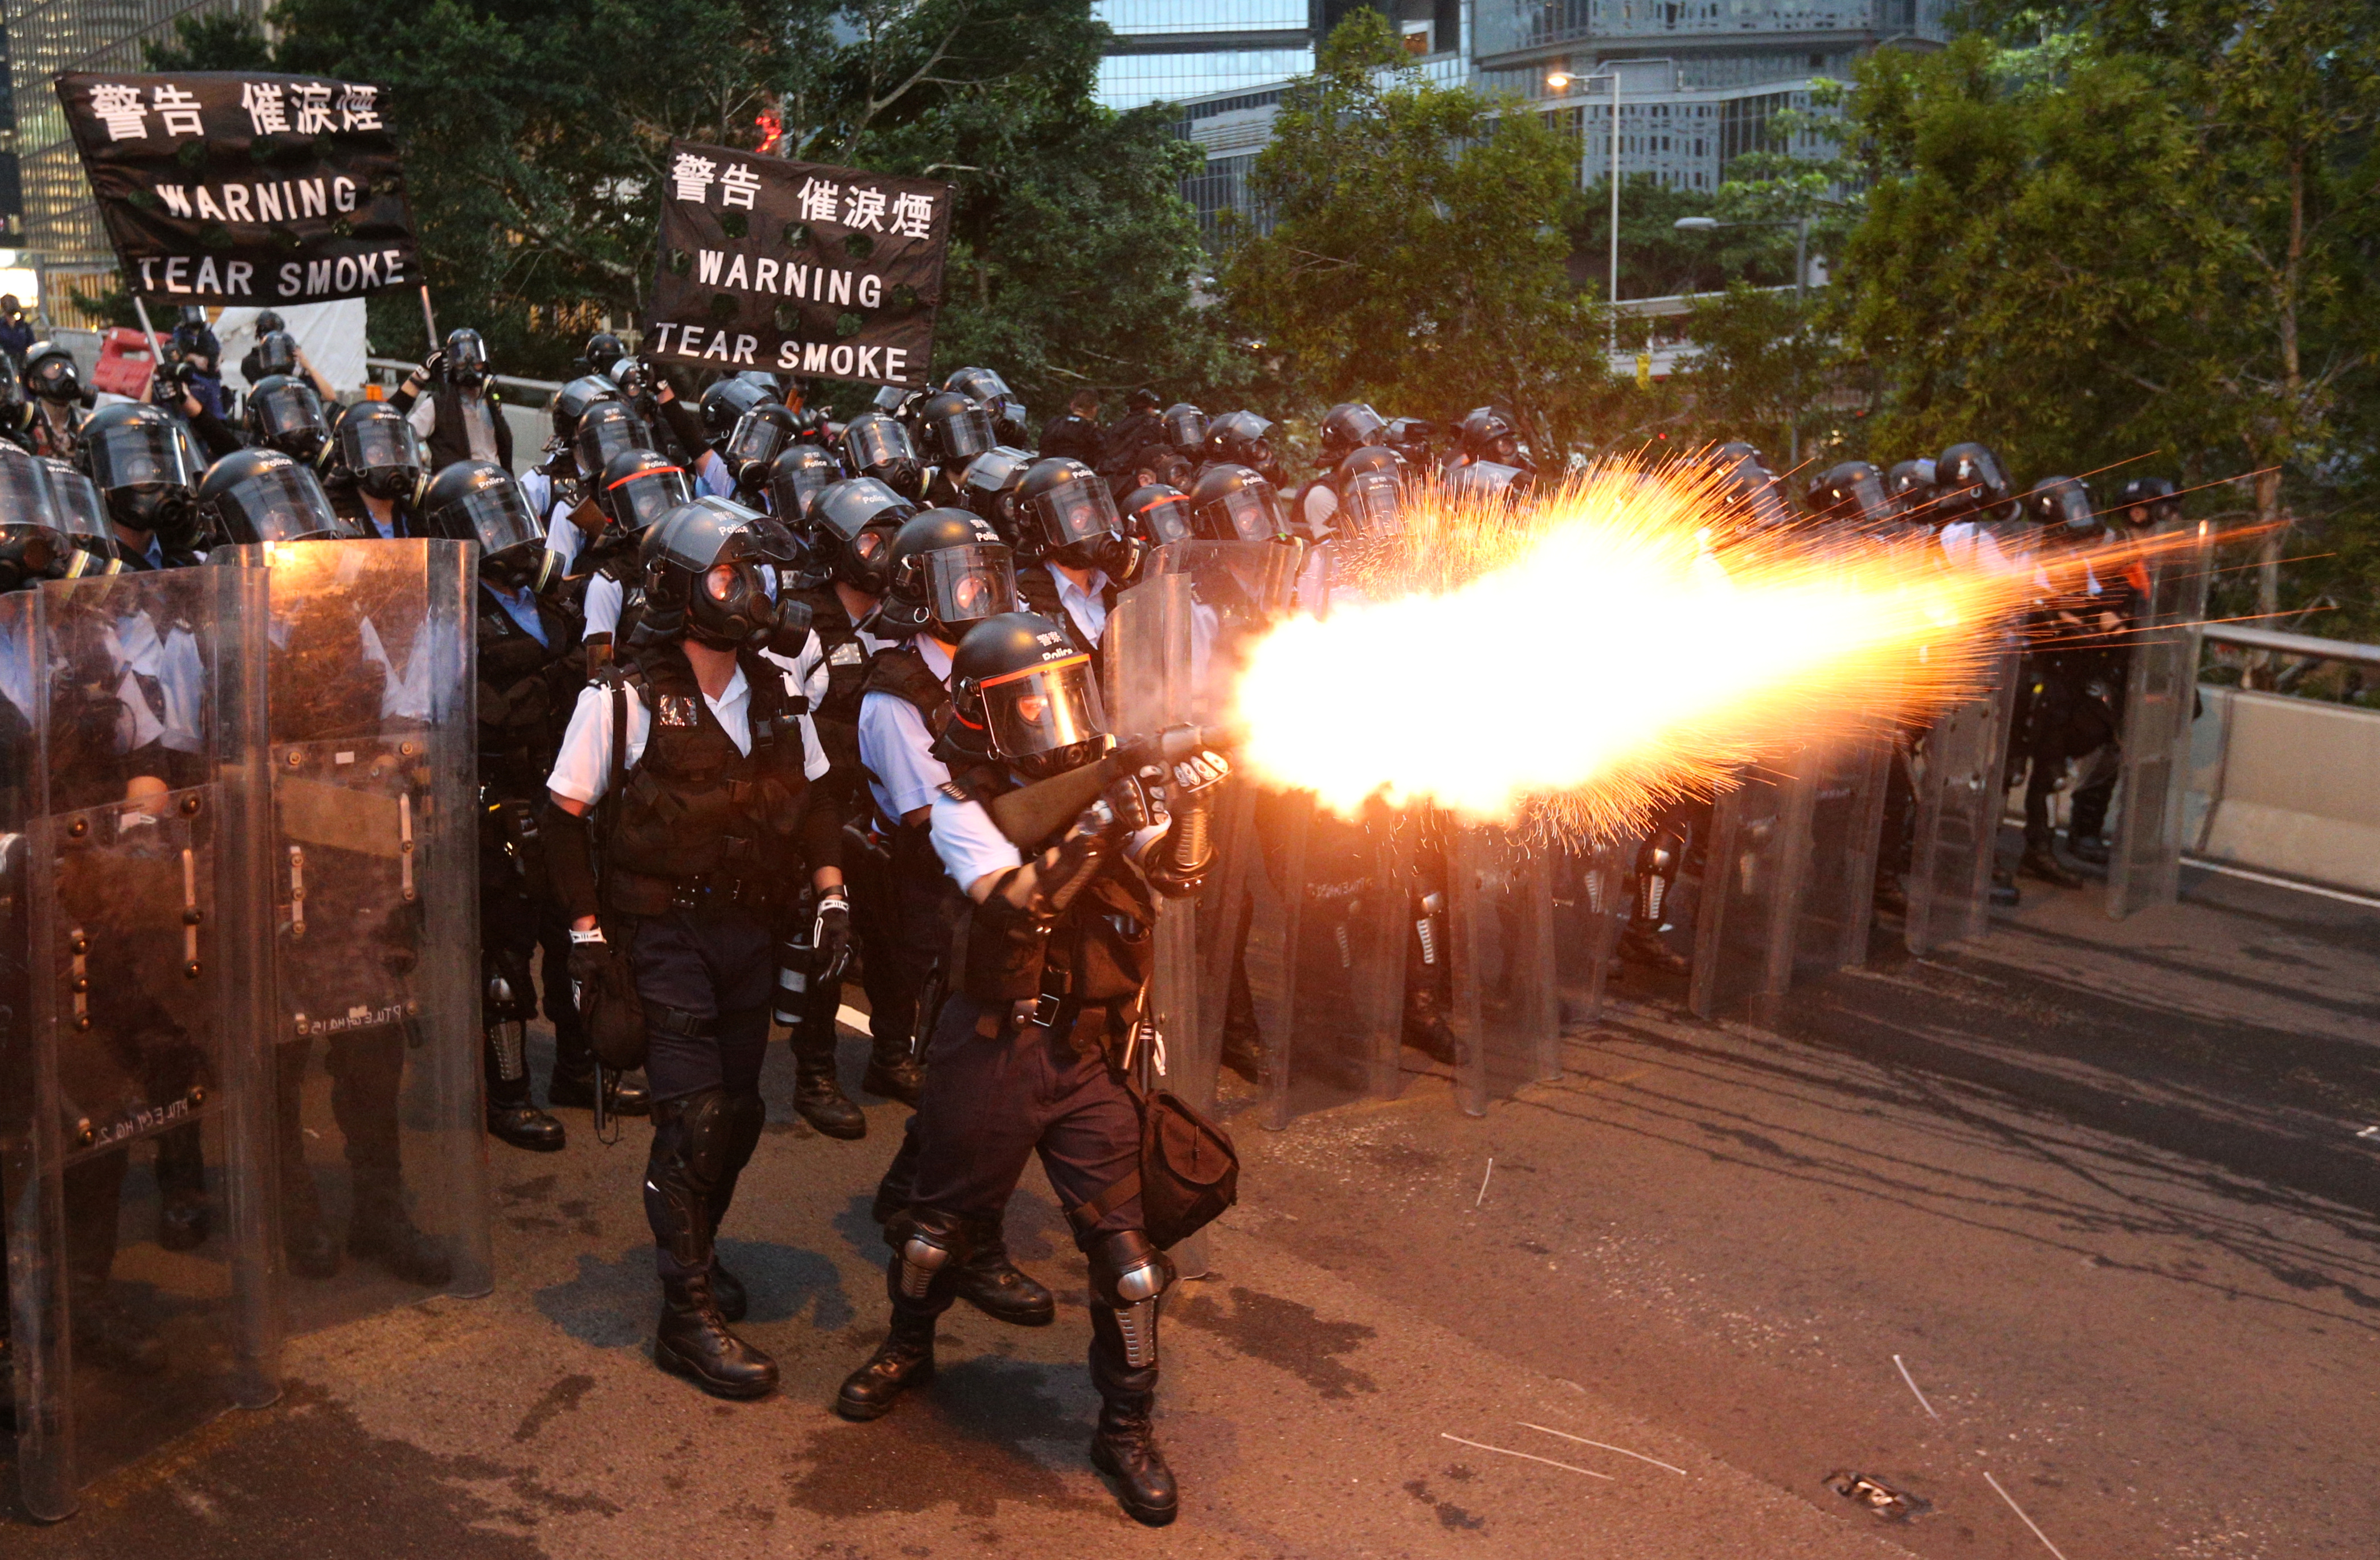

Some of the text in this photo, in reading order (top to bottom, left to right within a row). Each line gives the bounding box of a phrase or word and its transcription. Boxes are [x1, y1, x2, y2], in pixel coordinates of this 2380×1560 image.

[89, 82, 383, 142] 警告 催淚煙
[156, 177, 357, 222] WARNING
[672, 152, 934, 240] 警告 催淚煙
[138, 249, 405, 296] TEAR SMOKE
[698, 249, 882, 308] WARNING
[656, 322, 908, 382] TEAR SMOKE
[644, 460, 668, 470] Police
[804, 460, 828, 468] Police
[1072, 470, 1094, 479] Police
[479, 477, 505, 489] Police
[1242, 476, 1263, 486] Police
[862, 495, 886, 504] Police
[718, 524, 749, 536] Police
[975, 531, 1000, 542] Police
